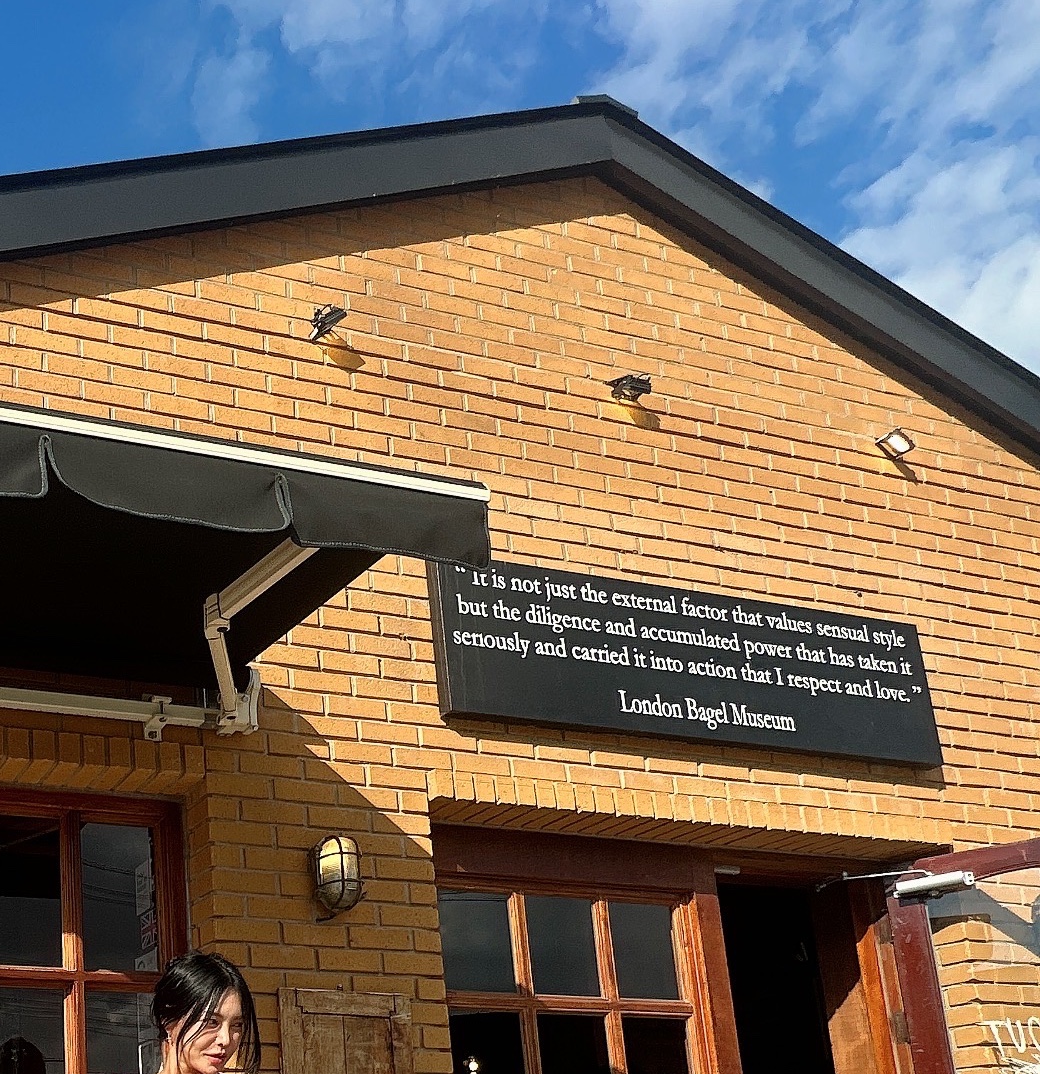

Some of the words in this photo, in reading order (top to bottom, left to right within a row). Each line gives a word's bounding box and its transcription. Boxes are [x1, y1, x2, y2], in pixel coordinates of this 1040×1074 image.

[456, 594, 488, 617] but
[492, 600, 521, 621] the
[526, 604, 601, 633] diligence
[605, 618, 637, 637] and
[640, 627, 741, 650] accumulated
[743, 640, 792, 659] power
[796, 643, 827, 663] that
[827, 647, 854, 667] has
[858, 654, 898, 673] taken
[900, 658, 912, 675] it
[492, 569, 506, 589] is
[511, 578, 542, 594] not
[545, 577, 577, 602] just
[580, 583, 608, 604] the
[612, 593, 678, 613] external
[681, 597, 728, 621] factor
[732, 605, 764, 626] that
[765, 612, 812, 634] values
[816, 623, 870, 642] sensual
[873, 630, 905, 651] style
[453, 631, 530, 658] seriously
[535, 638, 567, 657] and
[572, 644, 630, 665] carried
[633, 648, 647, 668] it
[650, 650, 683, 672] into
[688, 659, 737, 679] action
[741, 663, 773, 684] that
[774, 667, 784, 685] I
[787, 674, 842, 696] respect
[845, 679, 873, 697] and
[618, 690, 683, 718] London
[685, 698, 730, 730] Bagel
[732, 703, 796, 731] Museum
